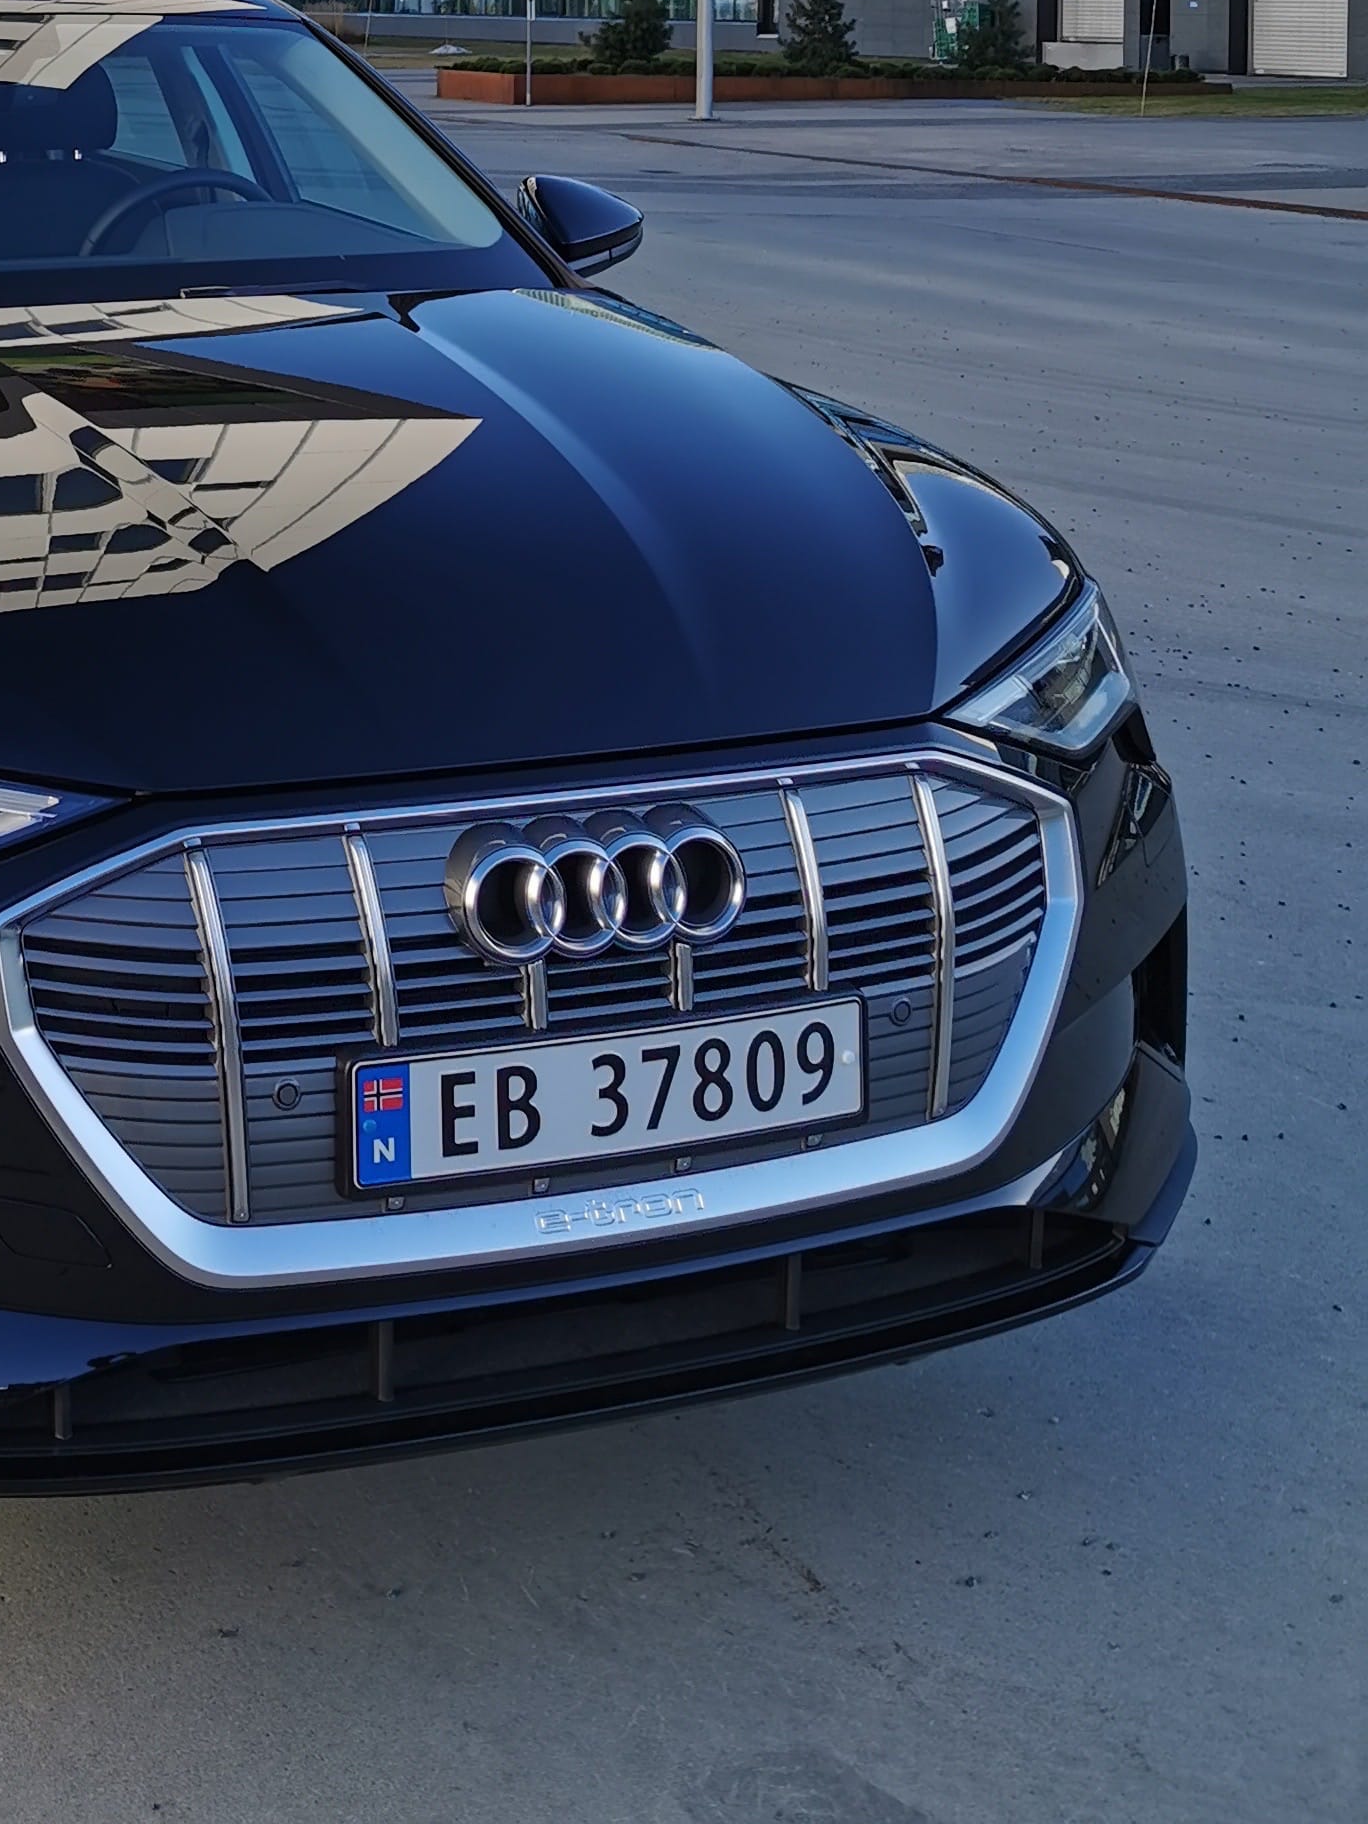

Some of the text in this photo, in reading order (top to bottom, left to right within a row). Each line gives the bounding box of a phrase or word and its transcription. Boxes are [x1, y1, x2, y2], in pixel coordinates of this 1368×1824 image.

[440, 1021, 834, 1157] EB 37809
[373, 1137, 396, 1164] N
[534, 1188, 705, 1234] e-tron
